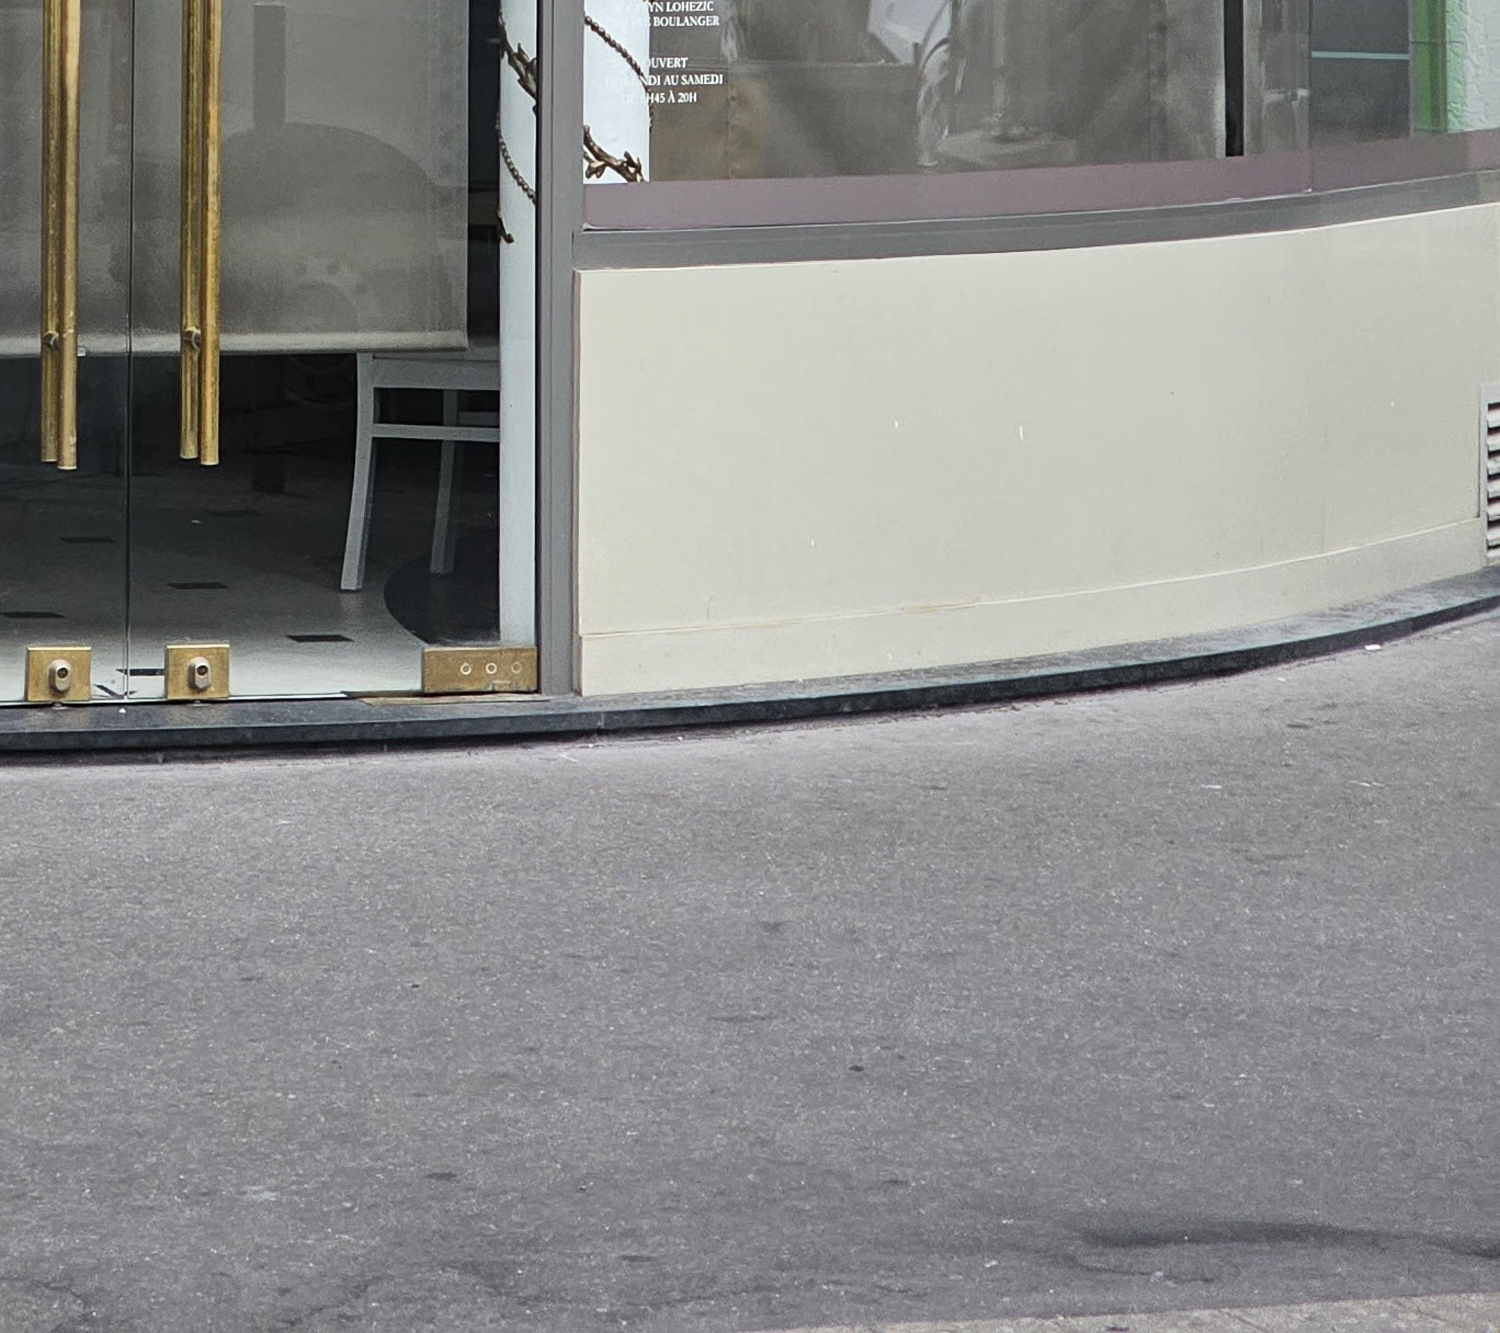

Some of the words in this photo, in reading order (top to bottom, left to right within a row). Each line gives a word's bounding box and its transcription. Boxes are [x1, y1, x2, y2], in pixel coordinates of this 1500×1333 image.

[666, 0, 714, 13] LOHEZIC
[653, 15, 720, 27] BOULANGER
[663, 74, 679, 86] AU
[681, 74, 723, 86] SAMEDI
[667, 89, 676, 104] À
[677, 91, 698, 104] 20H
